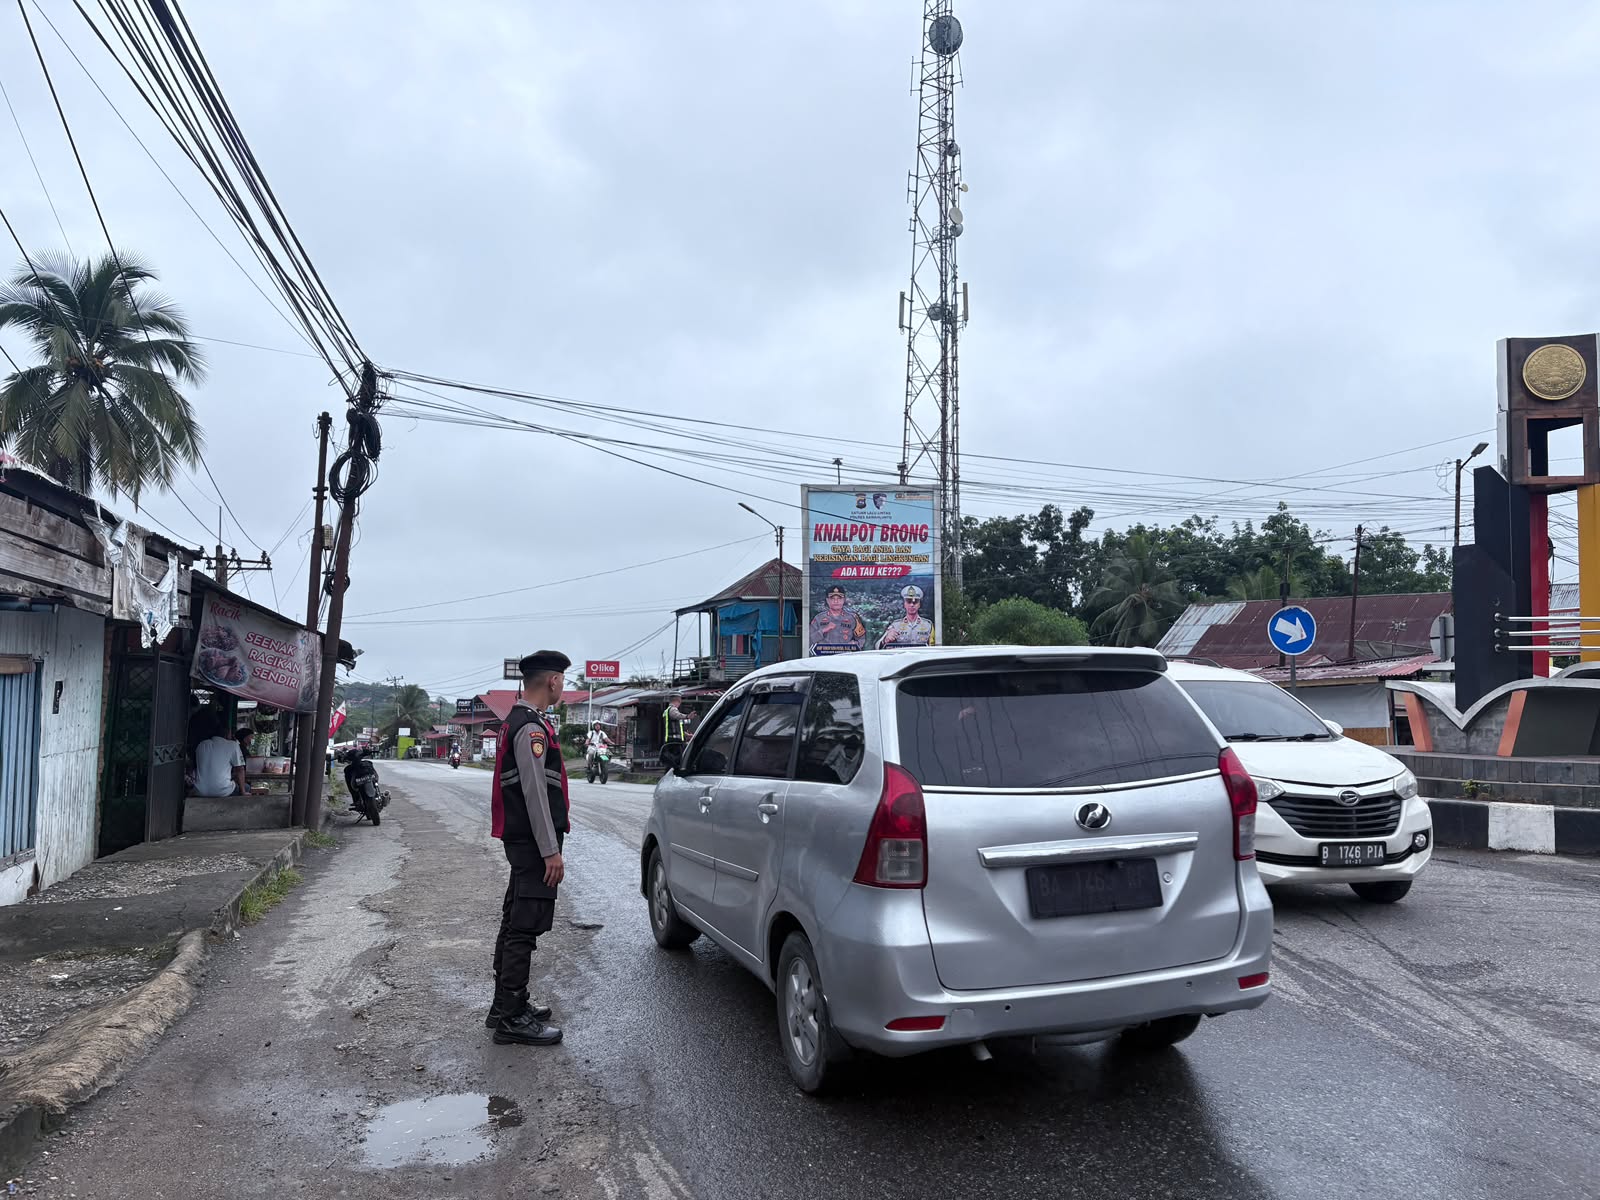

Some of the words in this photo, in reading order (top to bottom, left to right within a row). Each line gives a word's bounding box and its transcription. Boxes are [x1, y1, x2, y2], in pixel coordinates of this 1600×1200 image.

[813, 523, 878, 542] KNALPOT
[880, 523, 929, 543] BRONG
[813, 554, 858, 562] KEBISINGAN
[861, 554, 879, 562] BAGI
[880, 554, 929, 562] LINGKUNGAN
[831, 545, 851, 554] GAYA
[853, 545, 871, 554] BAGI
[873, 545, 893, 554] ANDA
[895, 545, 911, 554] DAN
[841, 567, 857, 576] ADA
[860, 567, 874, 576] TAU
[877, 567, 902, 576] KE???
[210, 601, 242, 621] Racik
[245, 632, 298, 657] SEENAK
[248, 648, 301, 674] RACIKAN
[252, 667, 300, 689] SENDIRI
[1322, 846, 1328, 859] B
[1339, 845, 1361, 859] 1746
[1367, 845, 1384, 858] PIA
